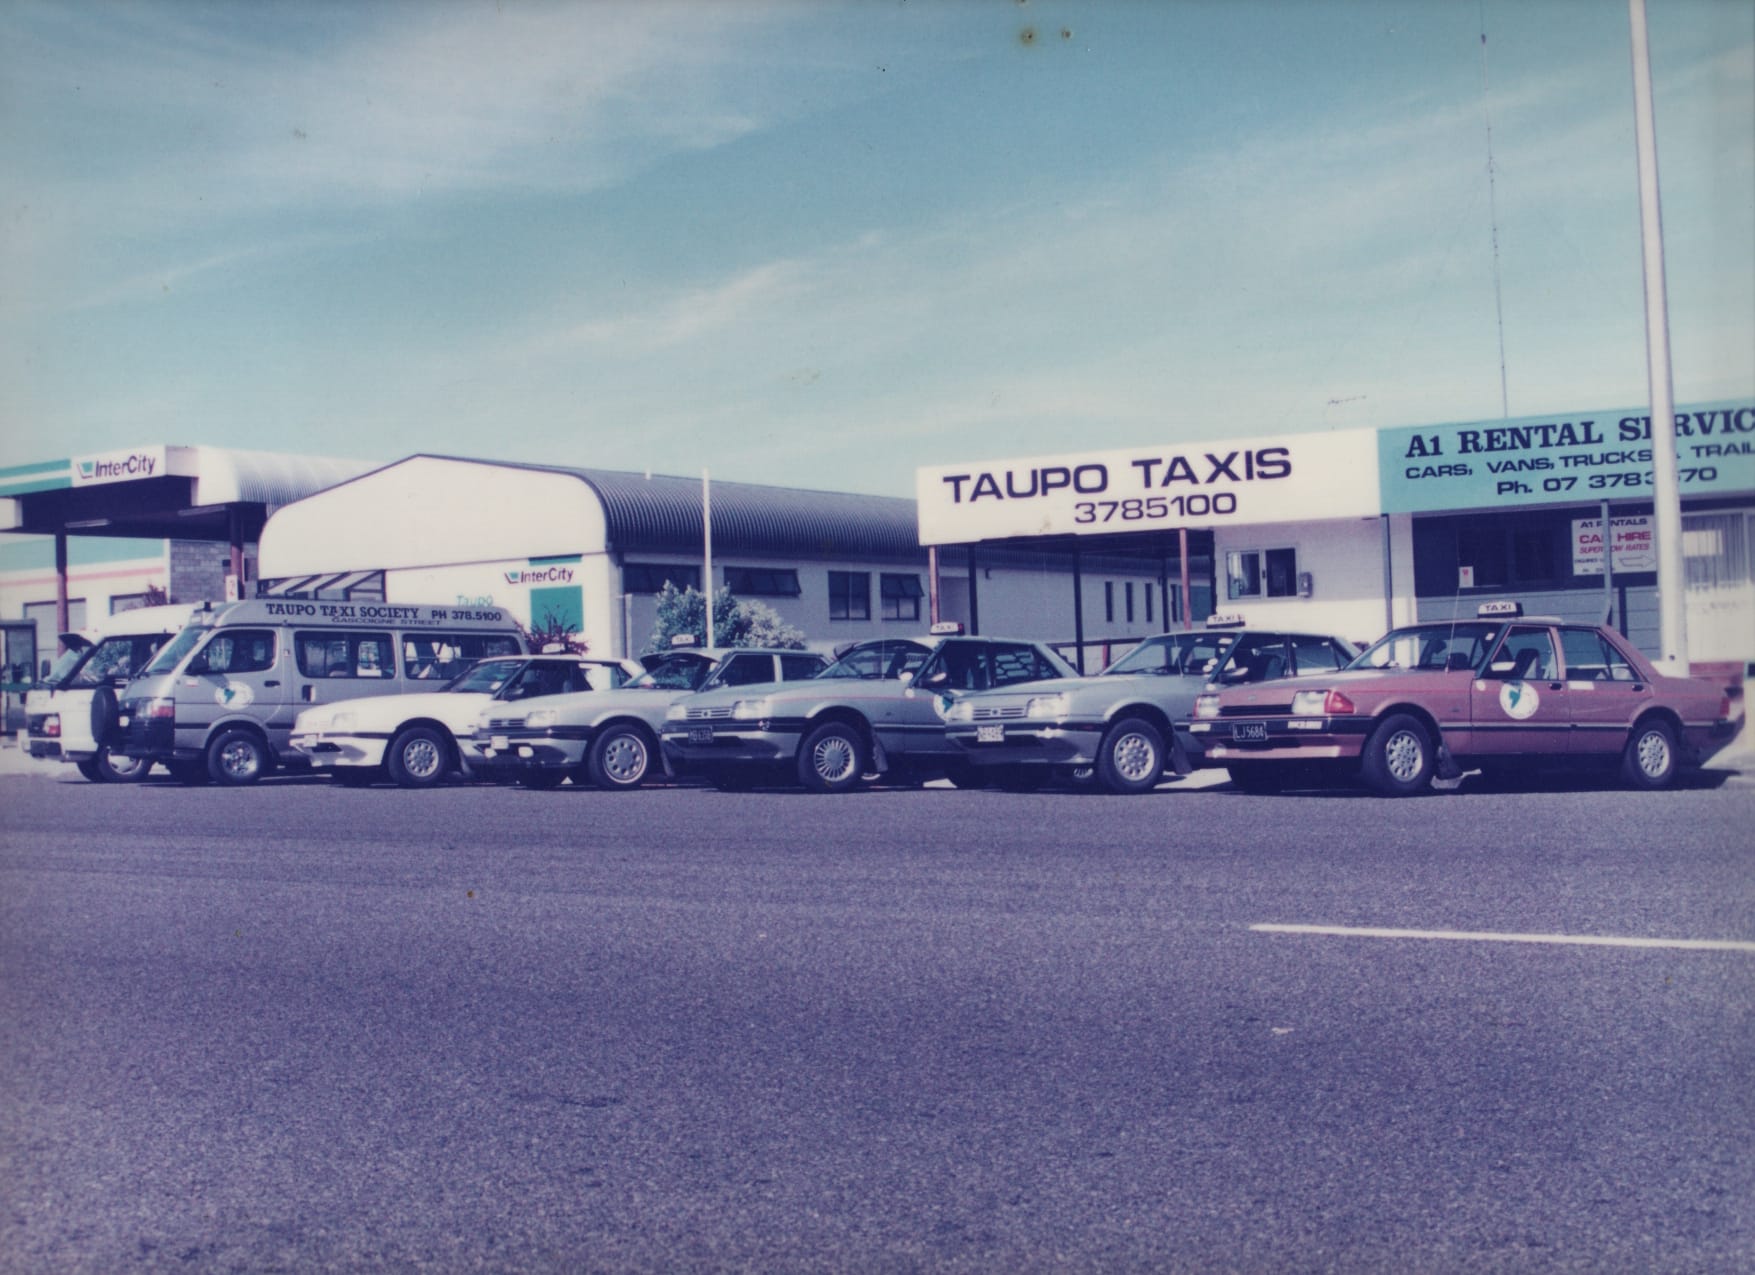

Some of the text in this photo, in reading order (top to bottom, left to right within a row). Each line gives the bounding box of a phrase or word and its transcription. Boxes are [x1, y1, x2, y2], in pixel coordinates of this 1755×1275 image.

[1405, 434, 1444, 459] A1
[1457, 421, 1604, 455] RENTAL
[95, 453, 156, 478] InterCity
[942, 446, 1293, 504] TAUPO TAXIS
[1405, 463, 1473, 480] CARS,
[1486, 457, 1556, 475] VANS,
[1559, 449, 1653, 470] TRUCKS
[1497, 466, 1718, 496] Ph. 07 378370
[1074, 492, 1238, 524] 3785100
[1580, 517, 1648, 529] A1 RNTALS
[1579, 530, 1652, 544] CA HIRE
[520, 567, 574, 583] InterCity
[265, 602, 502, 621] TAUPO TAXI SOCIETY PH 378.5100
[1486, 603, 1512, 612] TAXI
